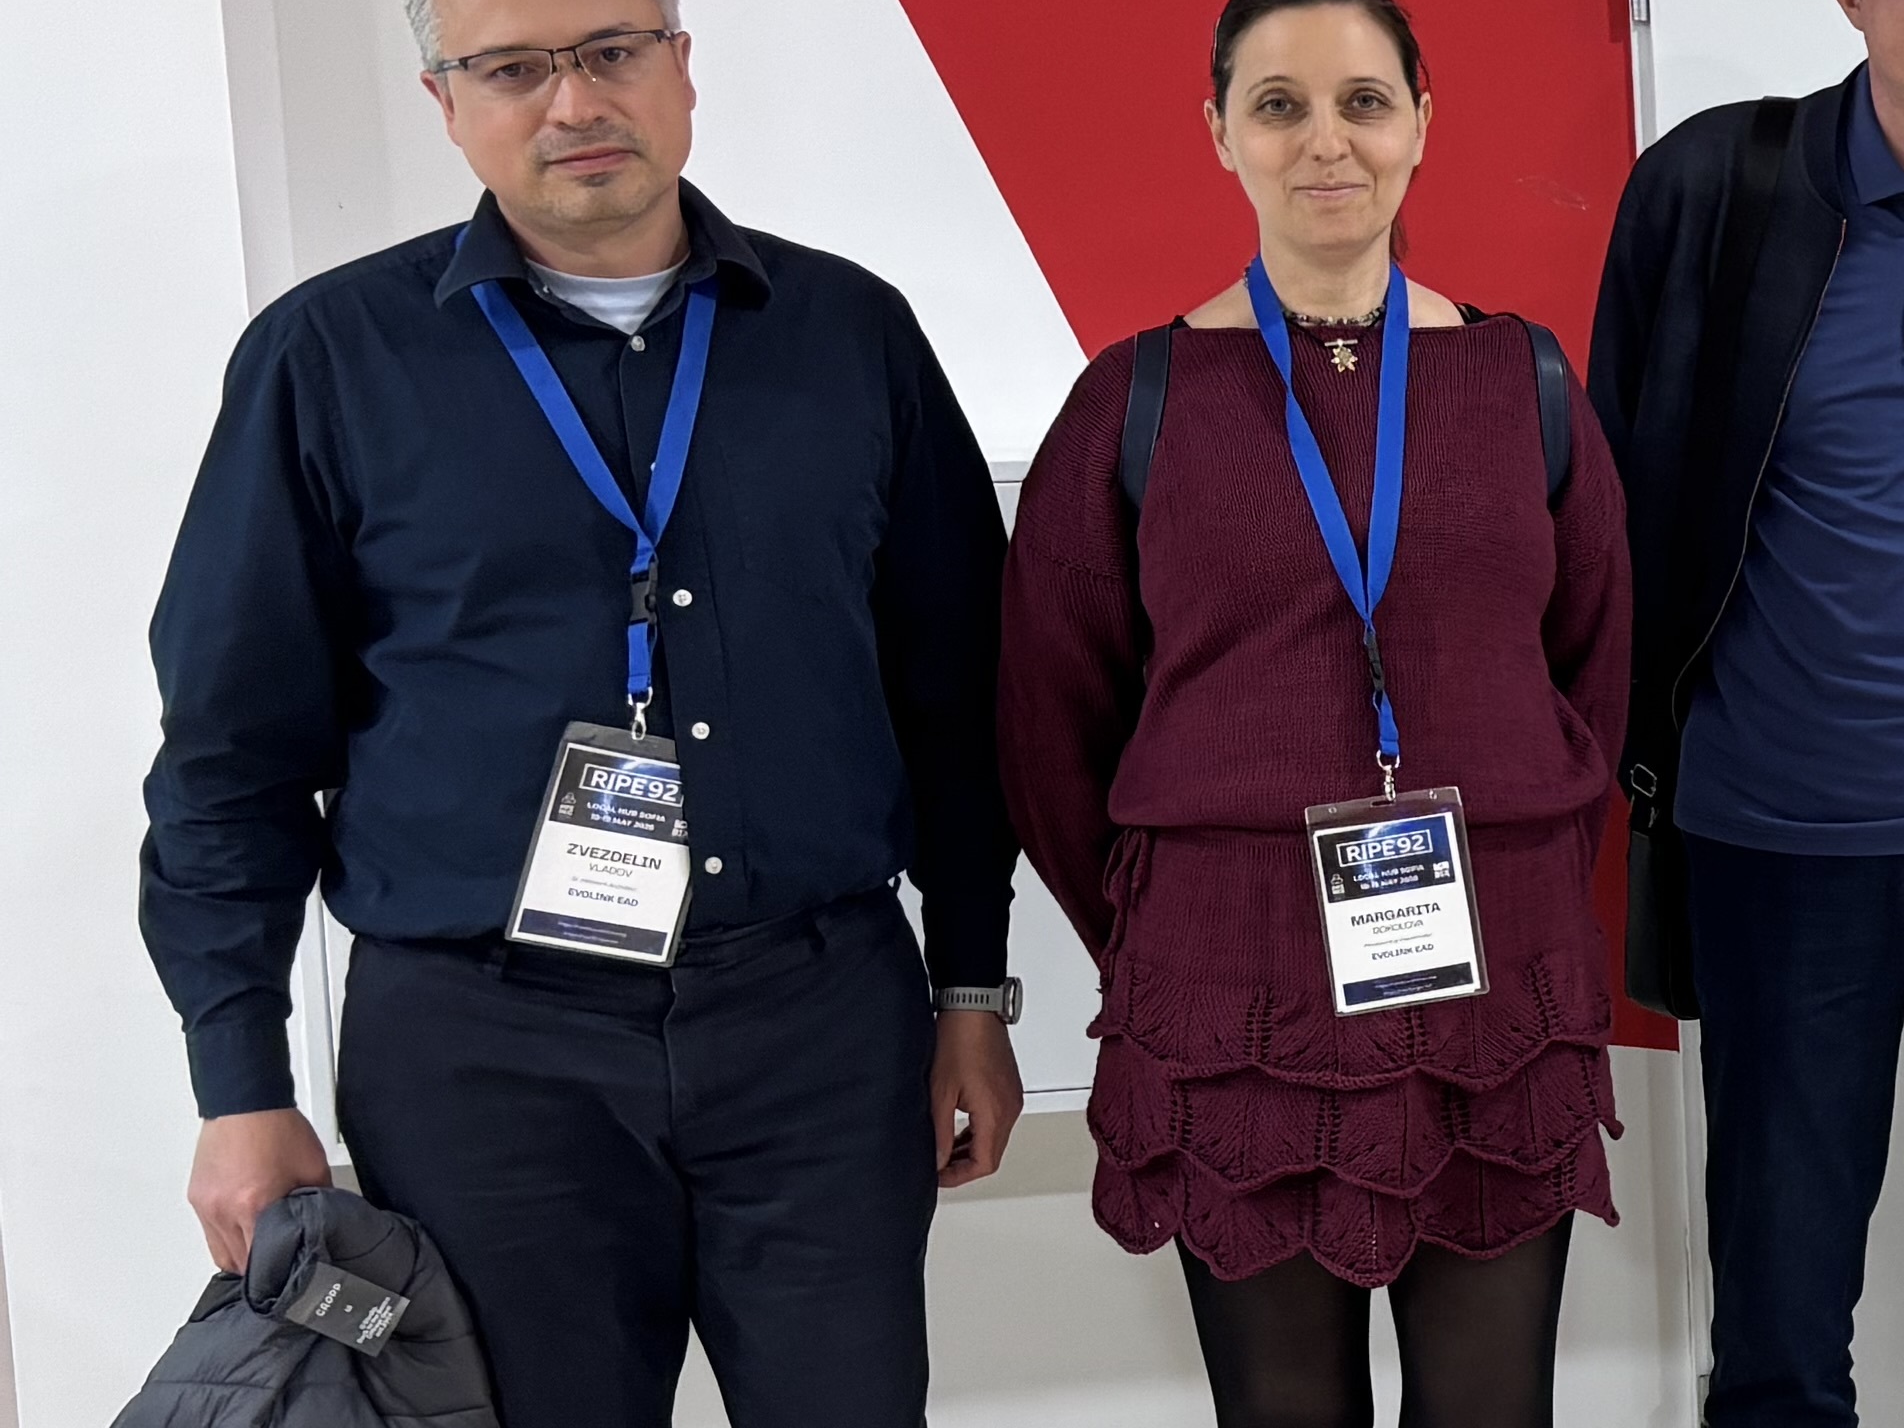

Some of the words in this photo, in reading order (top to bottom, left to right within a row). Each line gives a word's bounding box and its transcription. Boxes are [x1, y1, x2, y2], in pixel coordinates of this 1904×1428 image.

[567, 843, 662, 870] ZVEZDELIN
[589, 863, 633, 877] VLADOV
[568, 888, 614, 903] EVOLINK
[617, 895, 639, 907] EAD
[1351, 902, 1441, 927] MARGARITA
